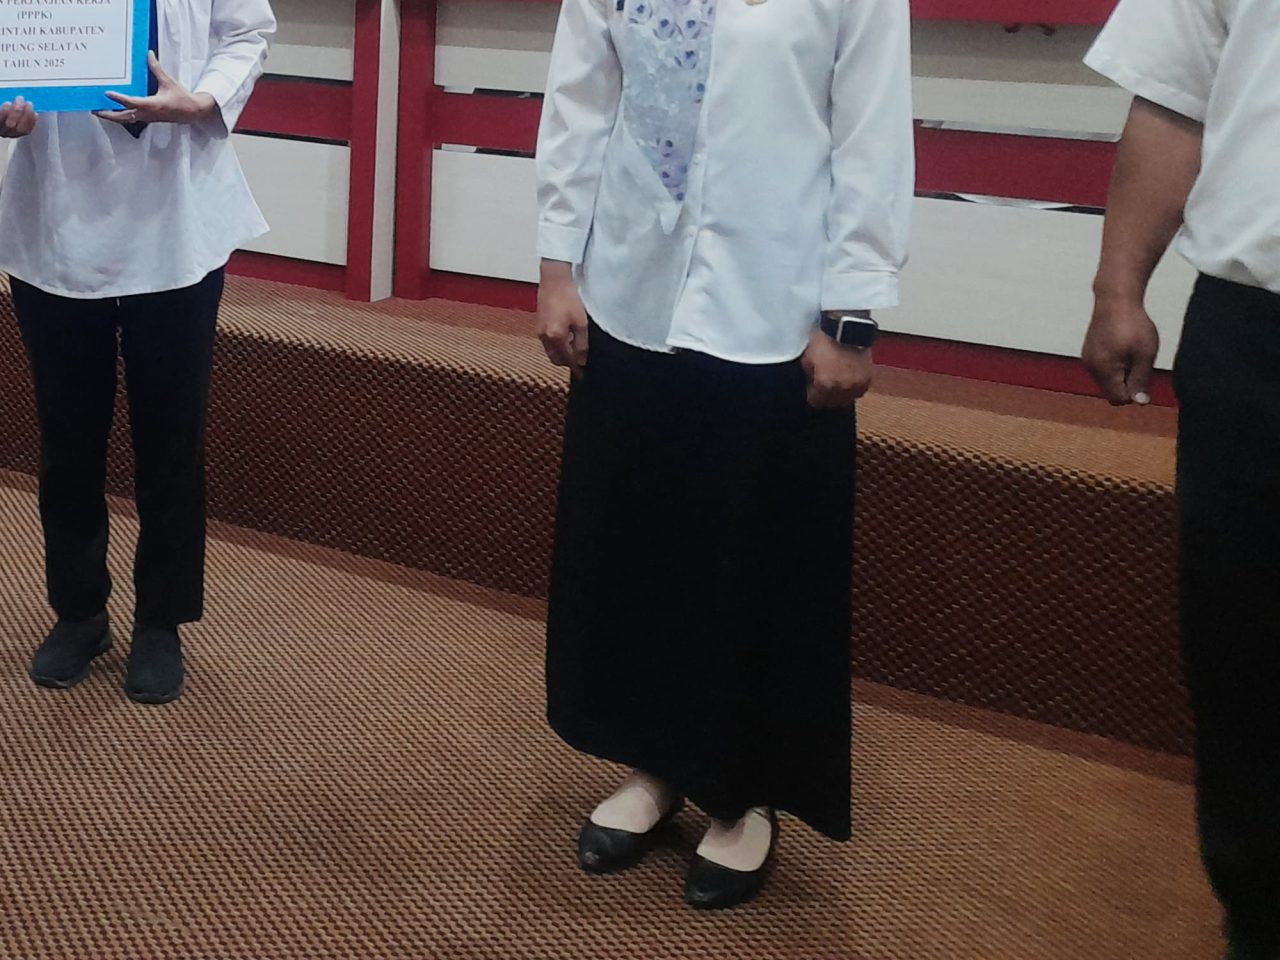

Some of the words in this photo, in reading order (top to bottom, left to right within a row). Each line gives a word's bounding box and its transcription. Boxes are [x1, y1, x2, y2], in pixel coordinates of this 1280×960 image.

[17, 10, 53, 20] (PPPK)
[39, 25, 105, 36] KABUPATEN
[38, 42, 88, 52] SELATAN
[3, 59, 41, 69] TAHUN
[43, 58, 65, 68] 2025
